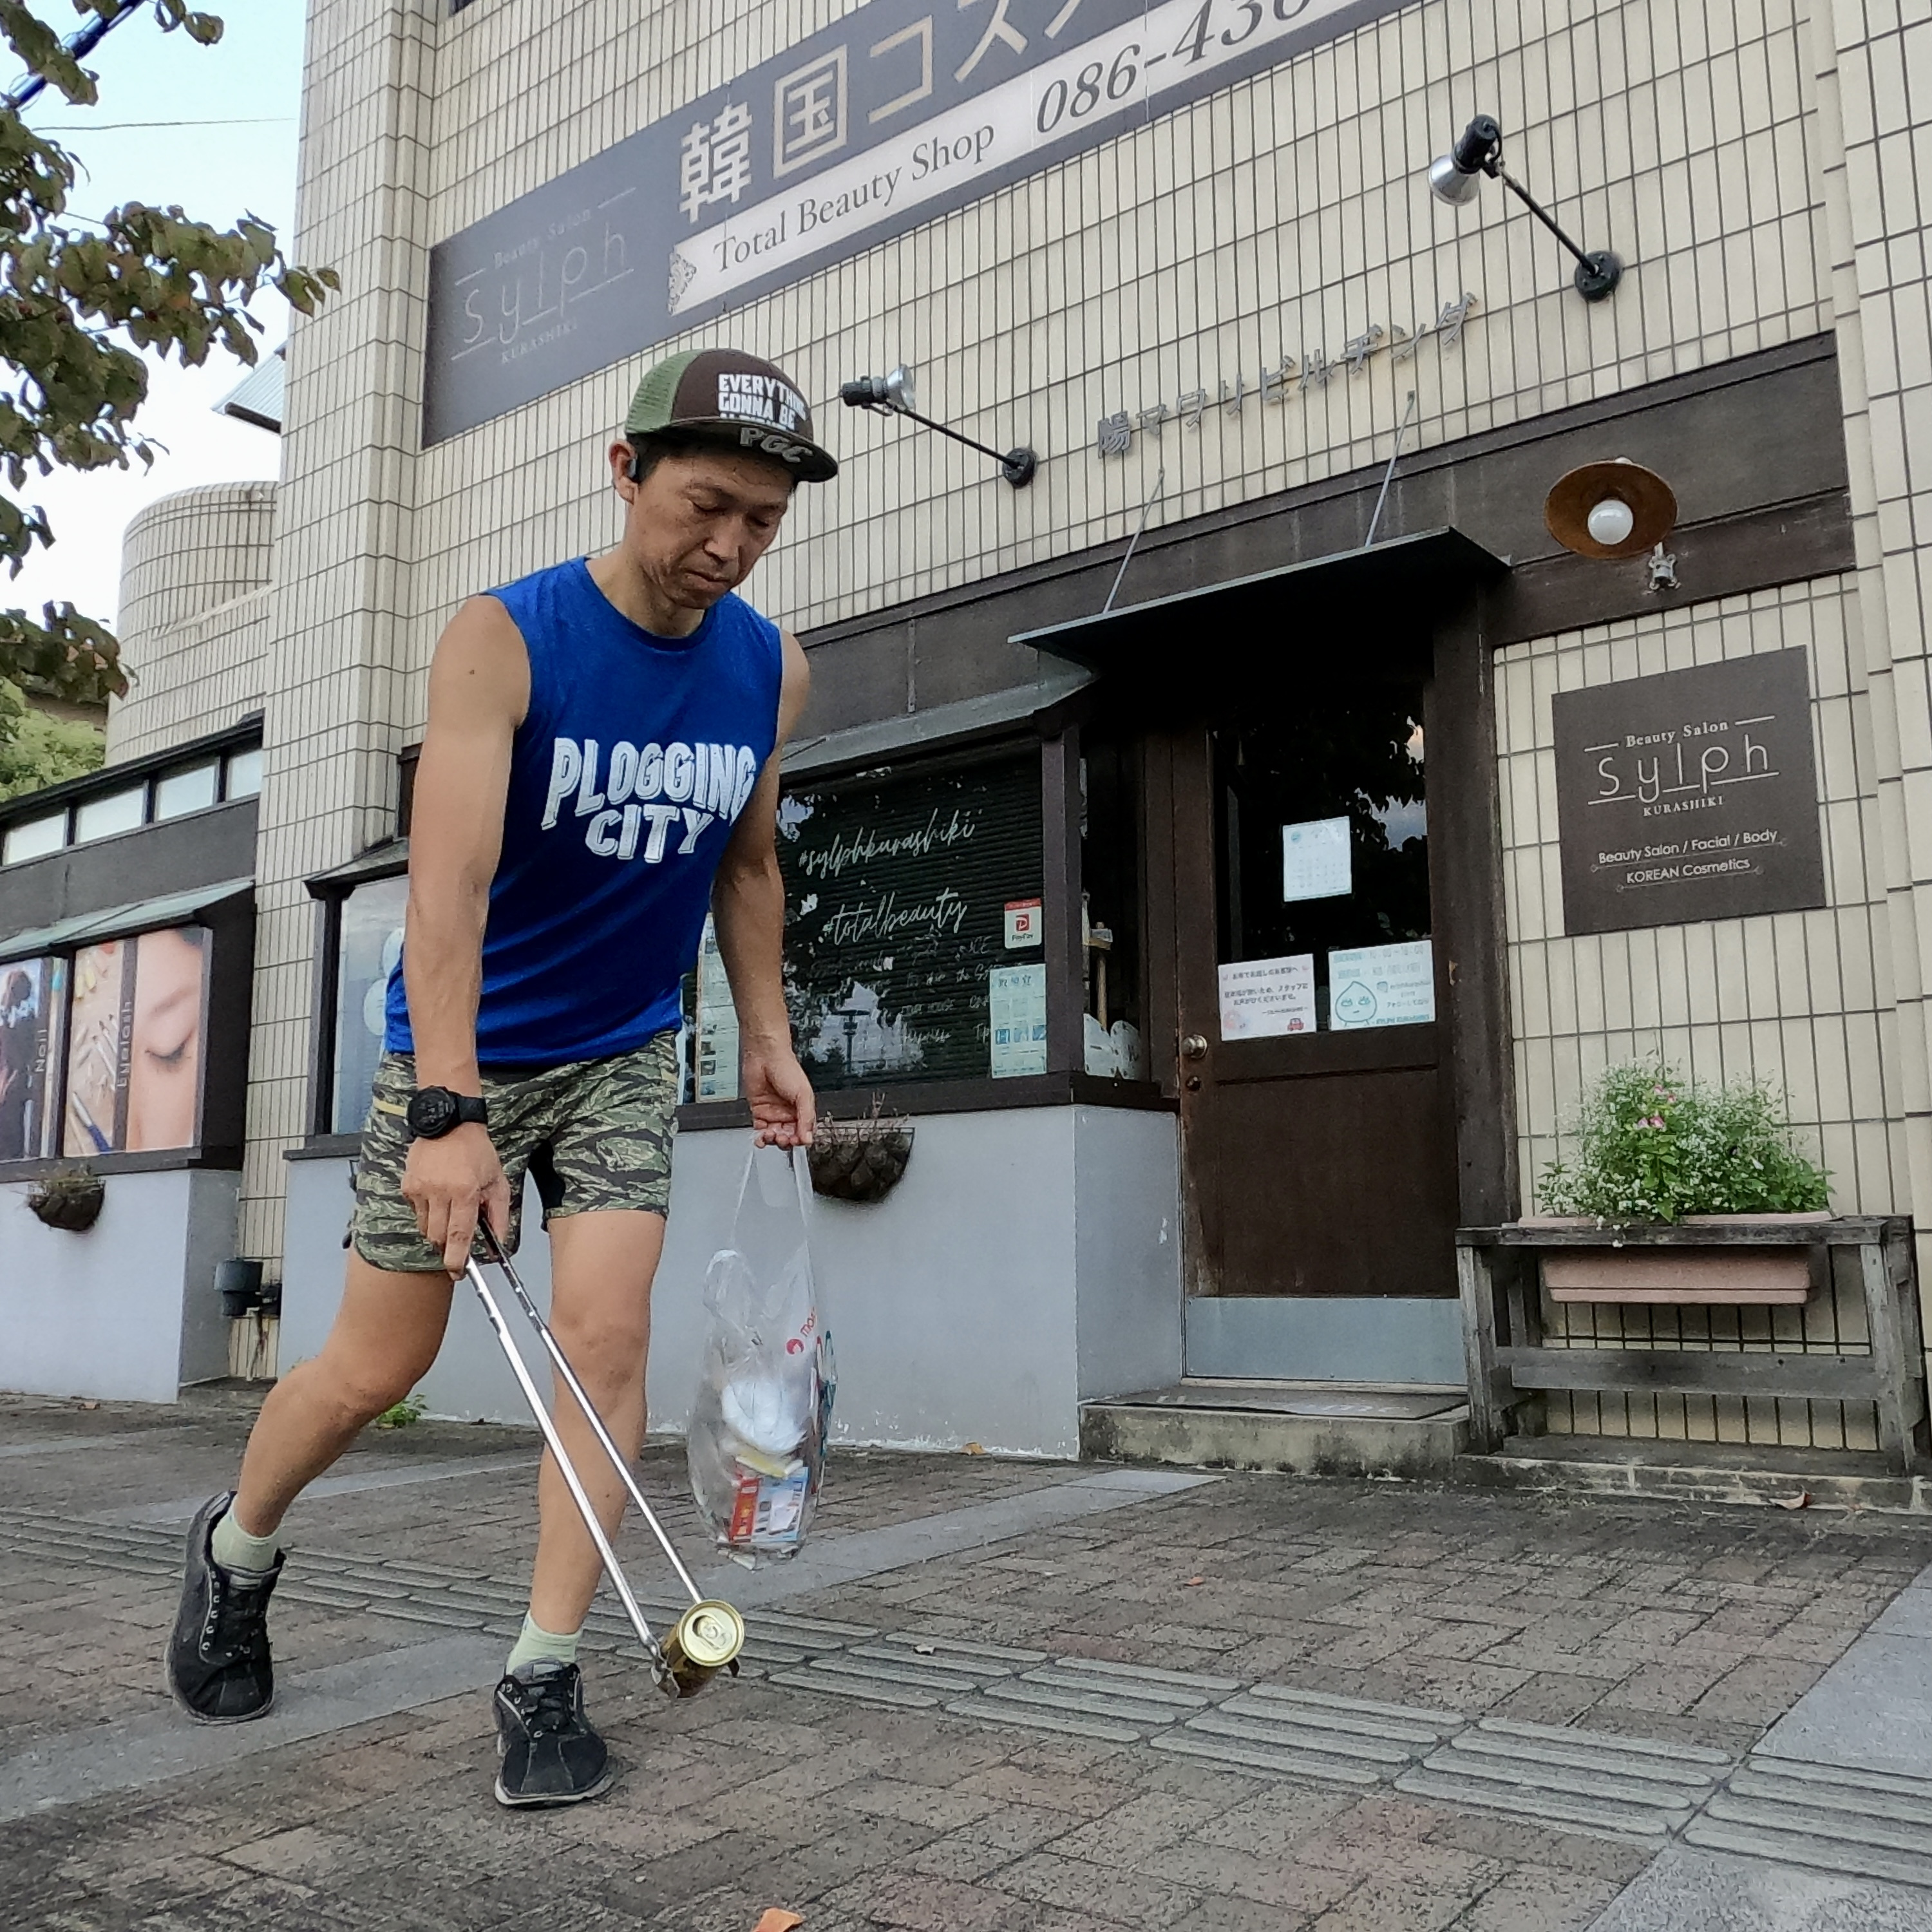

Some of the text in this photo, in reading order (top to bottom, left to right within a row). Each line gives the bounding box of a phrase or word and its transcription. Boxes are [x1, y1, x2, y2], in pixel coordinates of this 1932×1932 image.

[679, 0, 1081, 223] 韓国コス
[713, 210, 787, 273] Total
[797, 167, 903, 236] Beauty
[912, 124, 995, 181] Shop
[718, 393, 774, 421] GONNA
[779, 403, 795, 431] BE
[1625, 721, 1728, 748] Beauty Salon
[541, 737, 757, 831] PLOGGING
[1598, 734, 1768, 804] Sylph
[1643, 796, 1724, 817] KURASHIKI
[585, 803, 715, 864] CITY
[1598, 829, 1778, 865] Beauty Salon / Facial / Body
[1626, 857, 1751, 884] KOREAN Cosmetics
[34, 1029, 48, 1073] Nail
